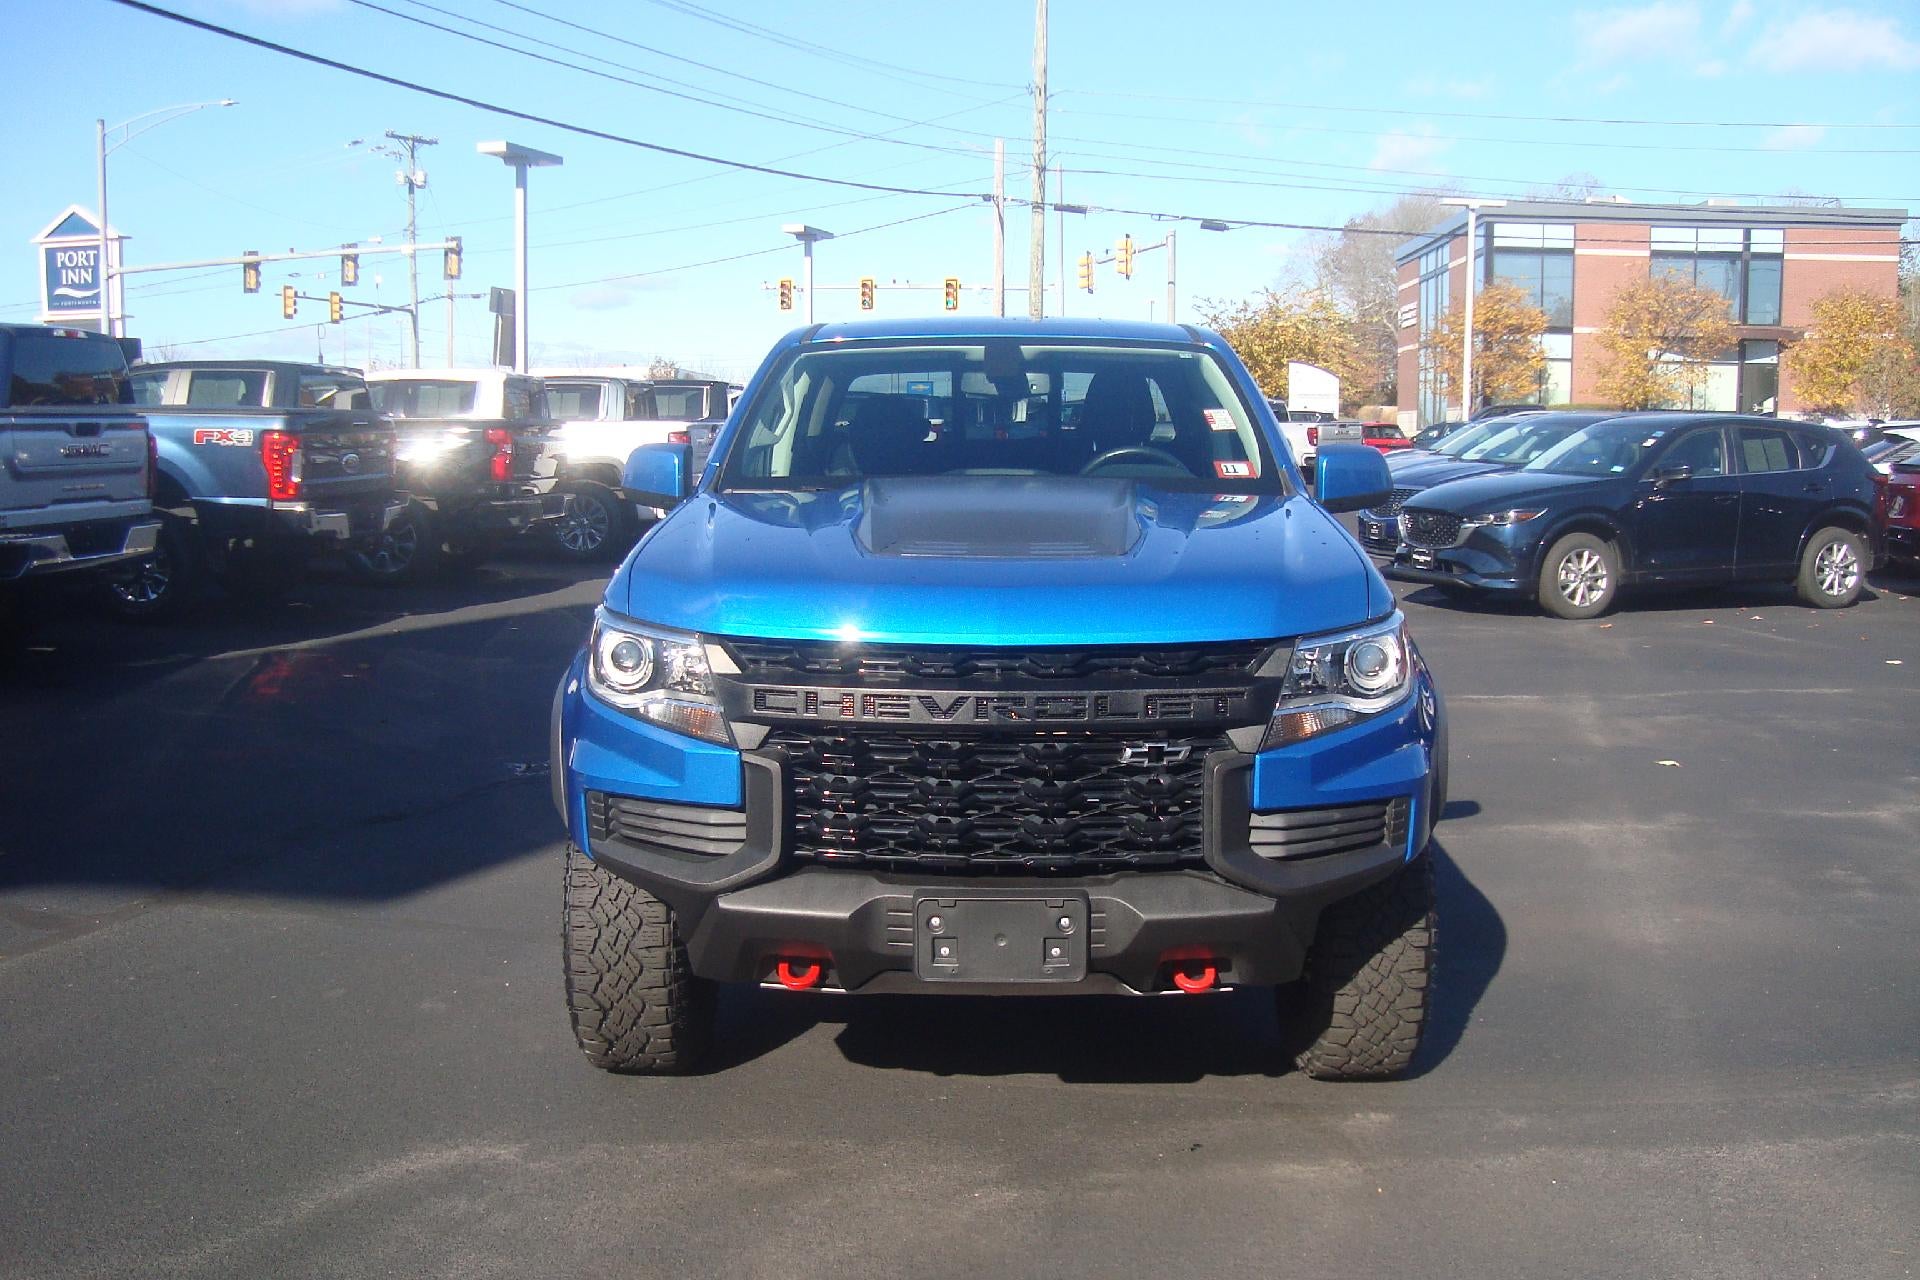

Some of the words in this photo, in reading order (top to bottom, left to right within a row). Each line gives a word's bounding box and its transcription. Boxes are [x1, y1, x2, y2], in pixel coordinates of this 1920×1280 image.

[56, 251, 98, 268] PORT
[62, 269, 93, 285] INN
[194, 428, 254, 445] FX4
[1223, 464, 1239, 474] 11
[753, 688, 1247, 720] CHEVROLET
